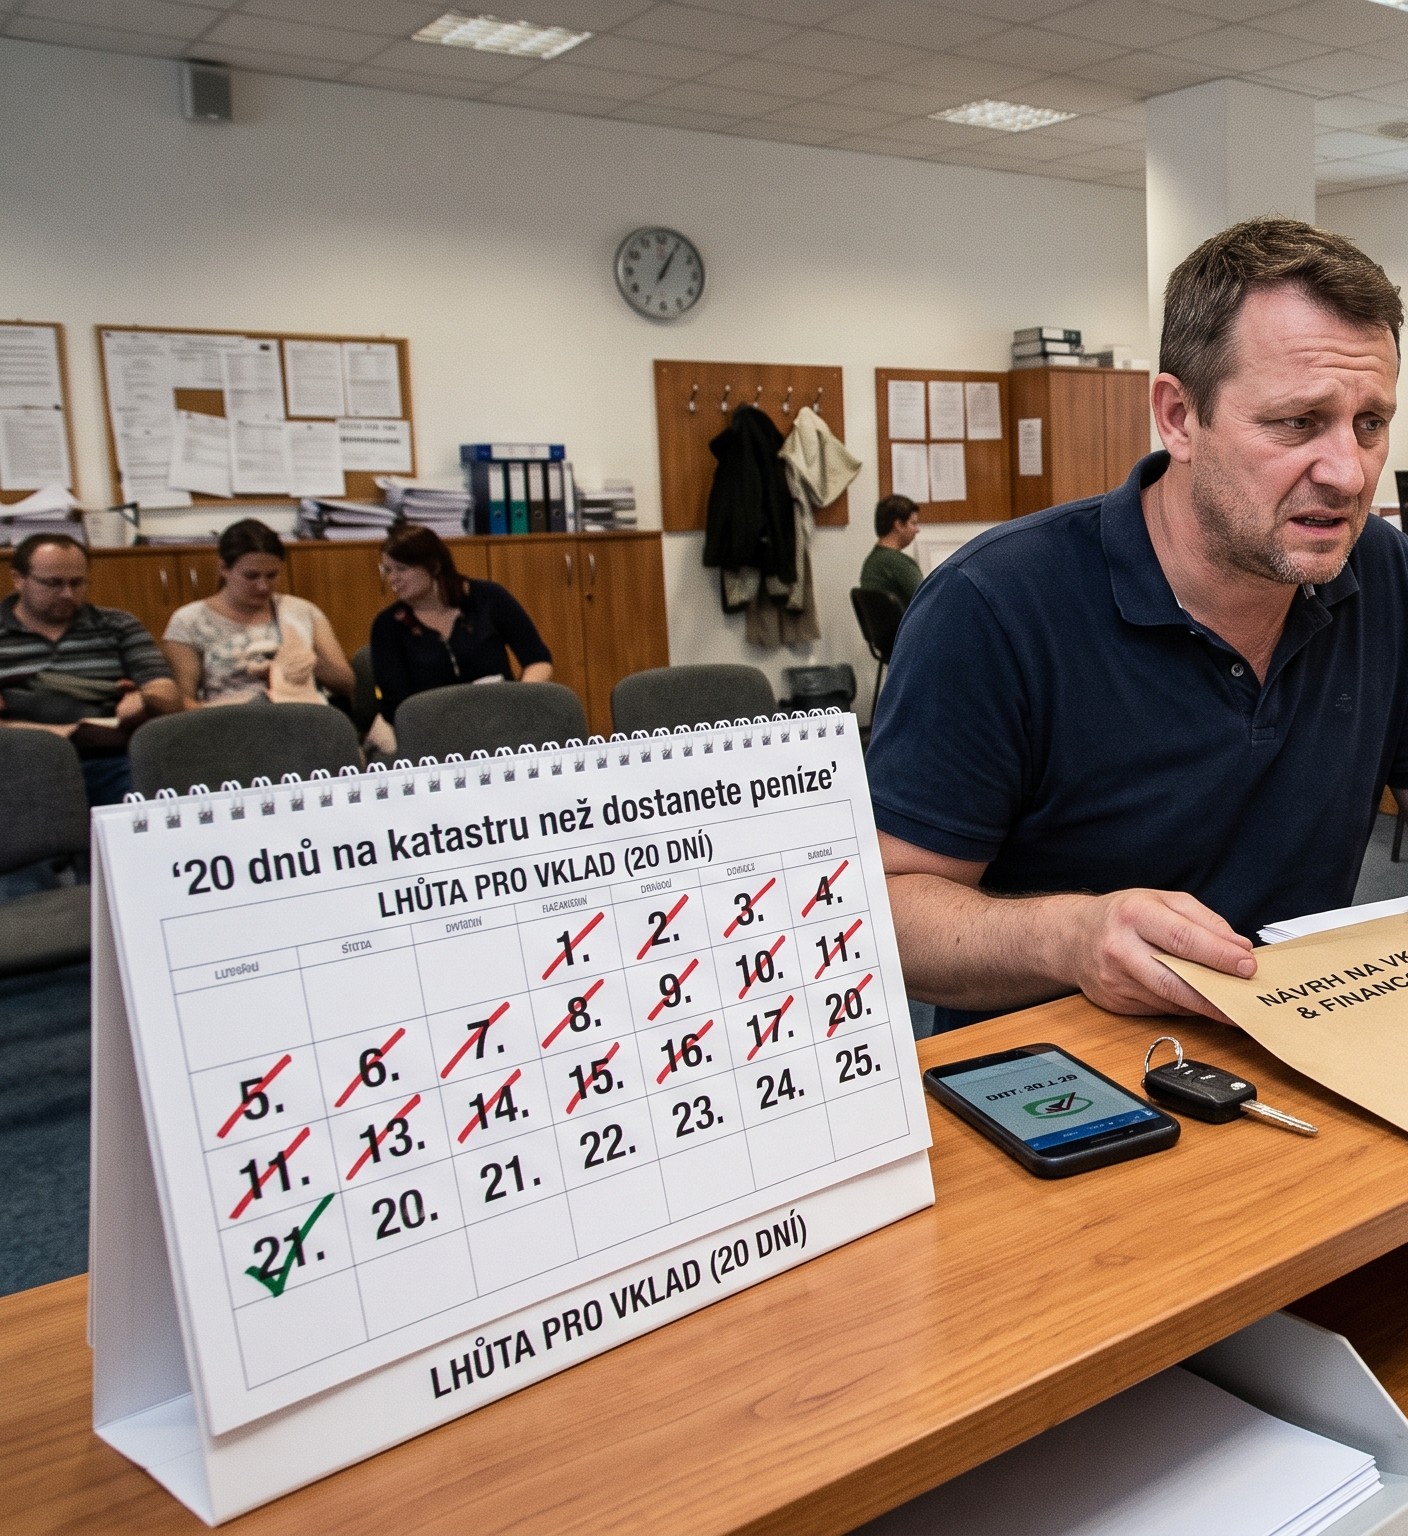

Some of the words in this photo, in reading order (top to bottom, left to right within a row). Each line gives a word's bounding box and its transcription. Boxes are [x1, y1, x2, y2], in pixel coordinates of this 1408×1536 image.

[248, 838, 320, 884] dnů
[332, 840, 377, 870] na
[387, 815, 528, 861] katastru
[538, 797, 593, 836] než
[602, 780, 741, 825] dostanete
[378, 877, 467, 917] LHŮTA
[474, 867, 526, 899] PRO
[533, 851, 615, 887] VKLAD
[624, 844, 659, 877] (20
[666, 828, 712, 863] DNÍ)
[556, 930, 589, 965] 1.
[648, 911, 679, 946] 2.
[734, 892, 763, 925] 3.
[816, 875, 842, 905] 4.
[240, 1077, 283, 1119] 5.
[359, 1048, 398, 1087] 6.
[467, 1019, 504, 1059] 7.
[567, 996, 601, 1032] 8.
[659, 973, 691, 1007] 9.
[735, 950, 783, 986] 10.
[815, 931, 860, 966] 11.
[1256, 972, 1345, 1008] NÁVRH
[1347, 962, 1385, 982] NA
[1296, 1004, 1320, 1020] &
[240, 1152, 309, 1199] 11.
[359, 1117, 424, 1162] 13.
[469, 1085, 528, 1129] 14.
[568, 1058, 623, 1099] 15.
[660, 1033, 712, 1072] 16.
[746, 1009, 793, 1046] 17.
[825, 989, 871, 1026] 20.
[252, 1225, 324, 1281] 21.
[372, 1189, 437, 1239] 20.
[480, 1156, 540, 1202] 21.
[580, 1124, 635, 1169] 22.
[672, 1095, 723, 1137] 23.
[756, 1068, 804, 1109] 24.
[835, 1045, 880, 1083] 25.
[430, 1329, 535, 1398] LHŮTA
[542, 1299, 602, 1350] PRO
[609, 1259, 700, 1318] VKLAD
[710, 1239, 748, 1283] (20
[755, 1208, 806, 1258] DNÍ)
